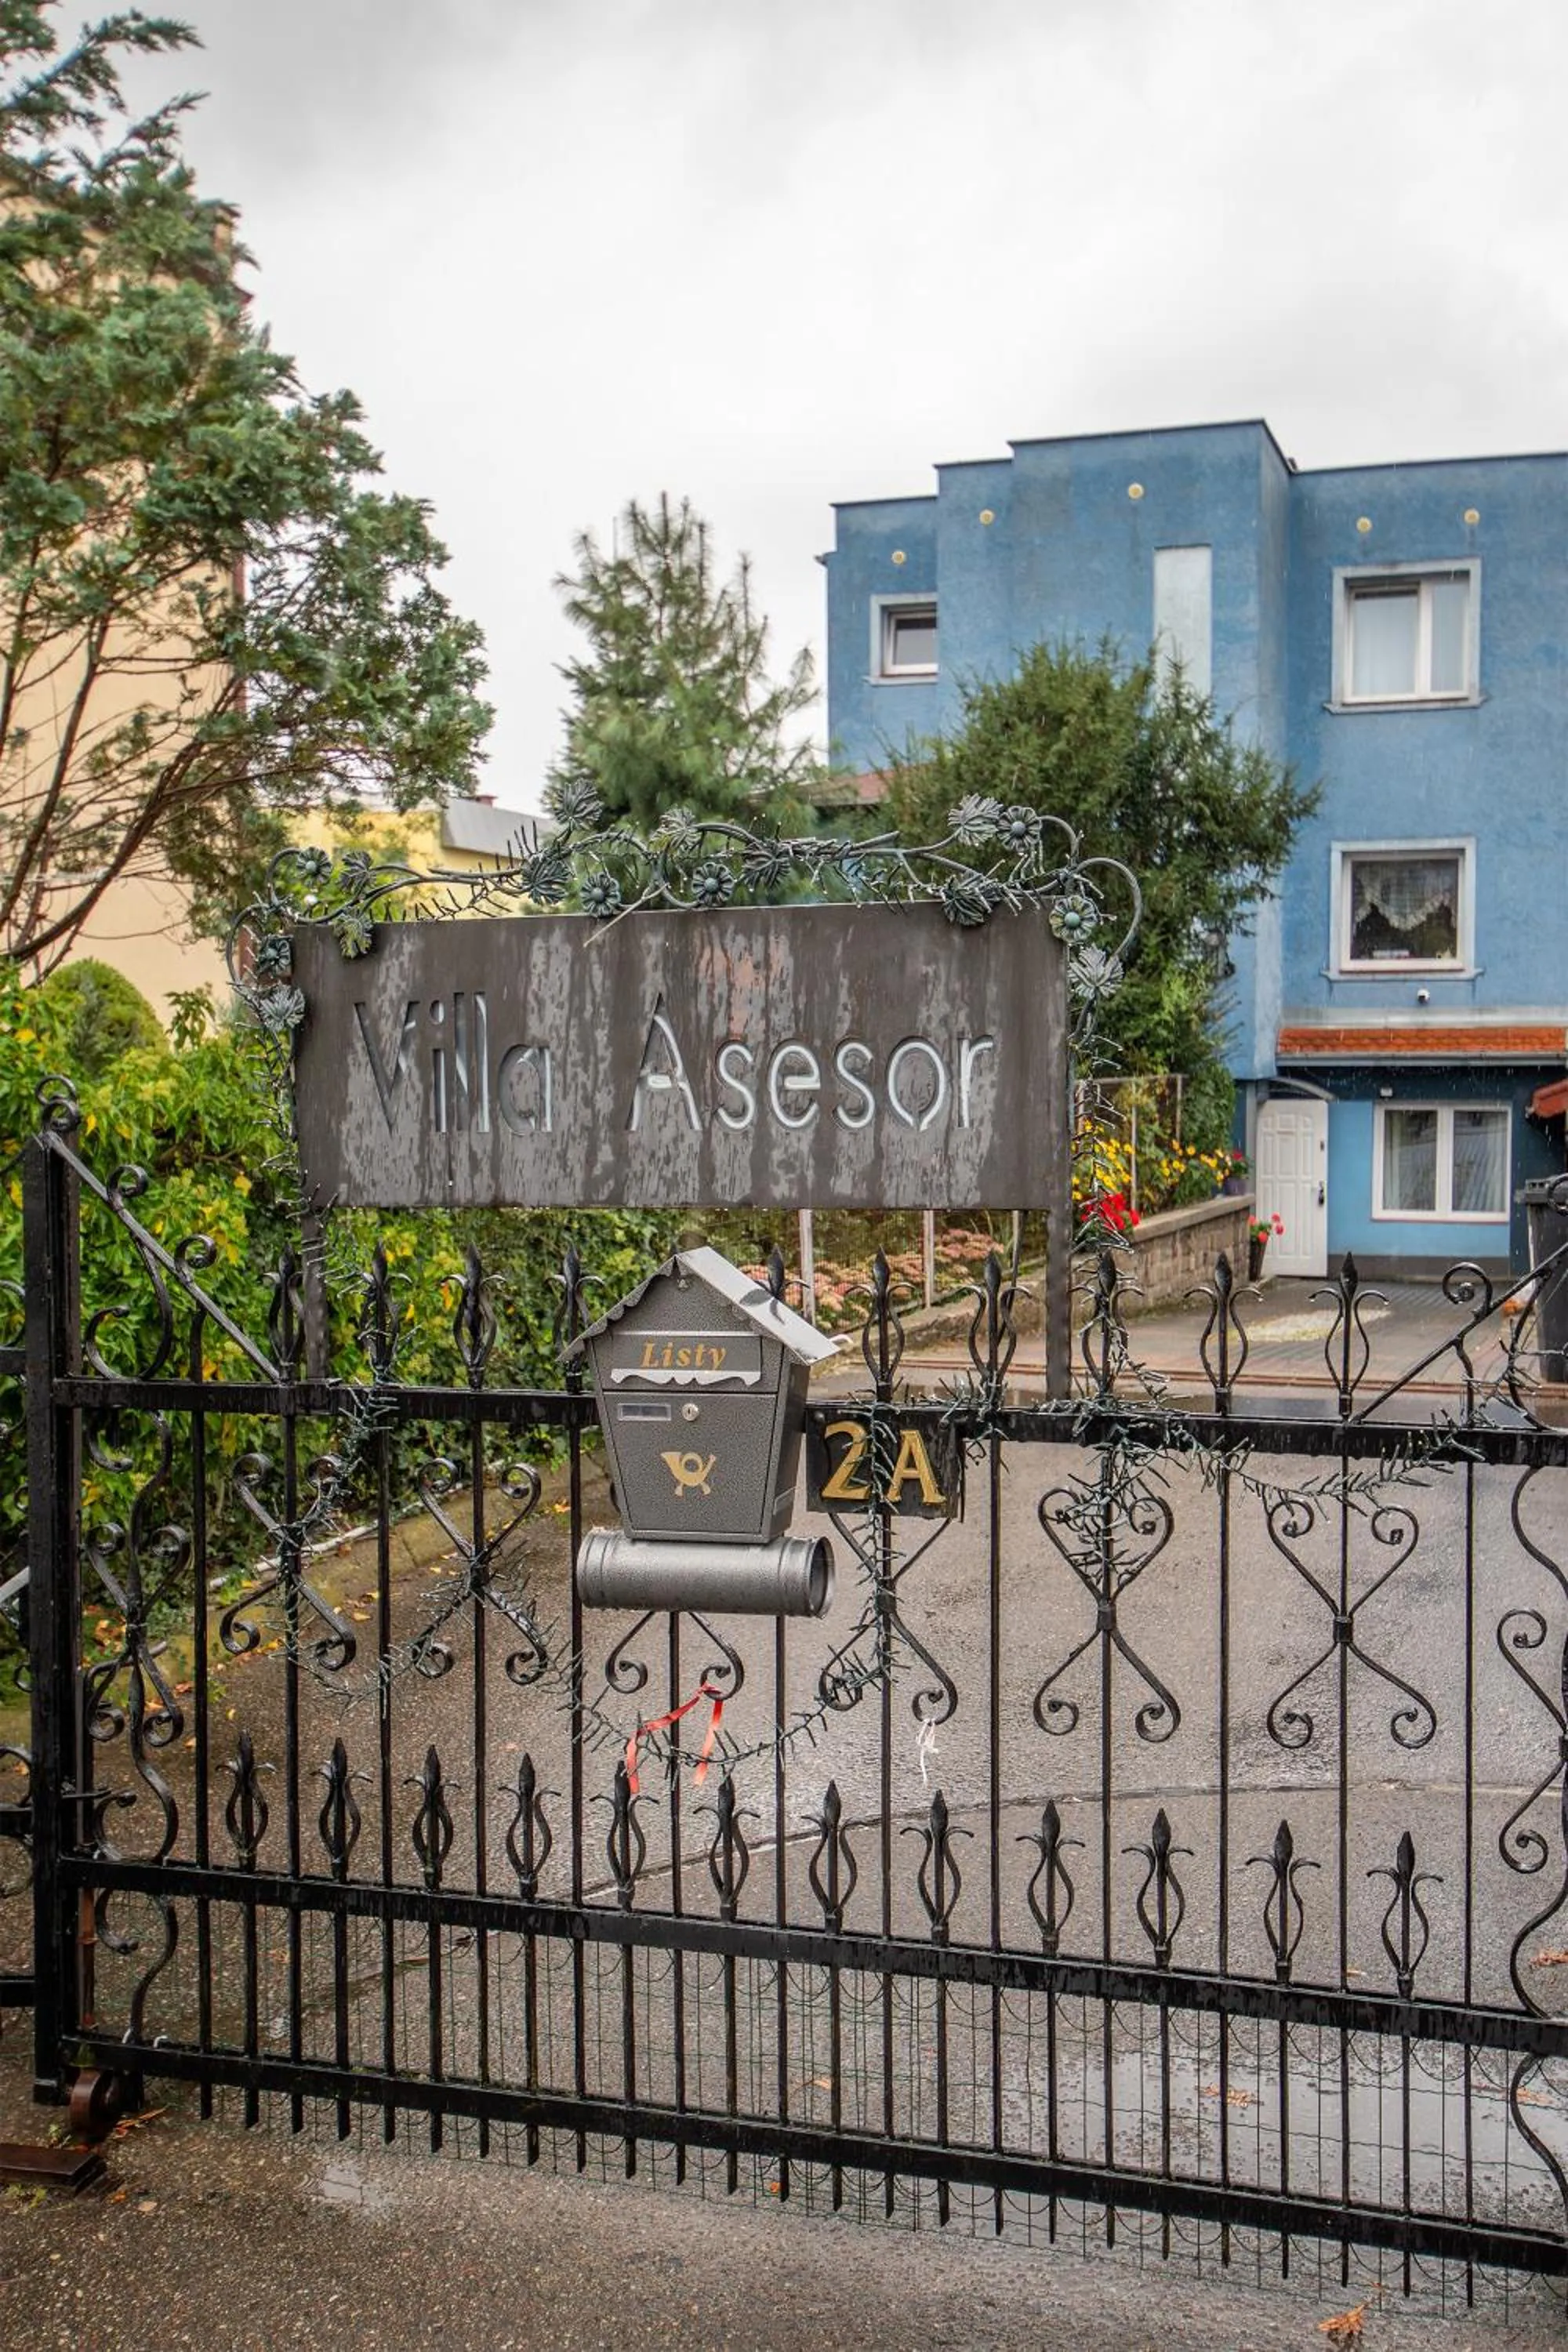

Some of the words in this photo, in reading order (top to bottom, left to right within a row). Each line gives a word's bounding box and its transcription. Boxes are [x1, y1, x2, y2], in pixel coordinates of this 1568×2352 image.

[353, 990, 554, 1135] Villa
[629, 991, 995, 1131] Asesor
[640, 1339, 727, 1371] Listy
[821, 1421, 947, 1505] 2A
